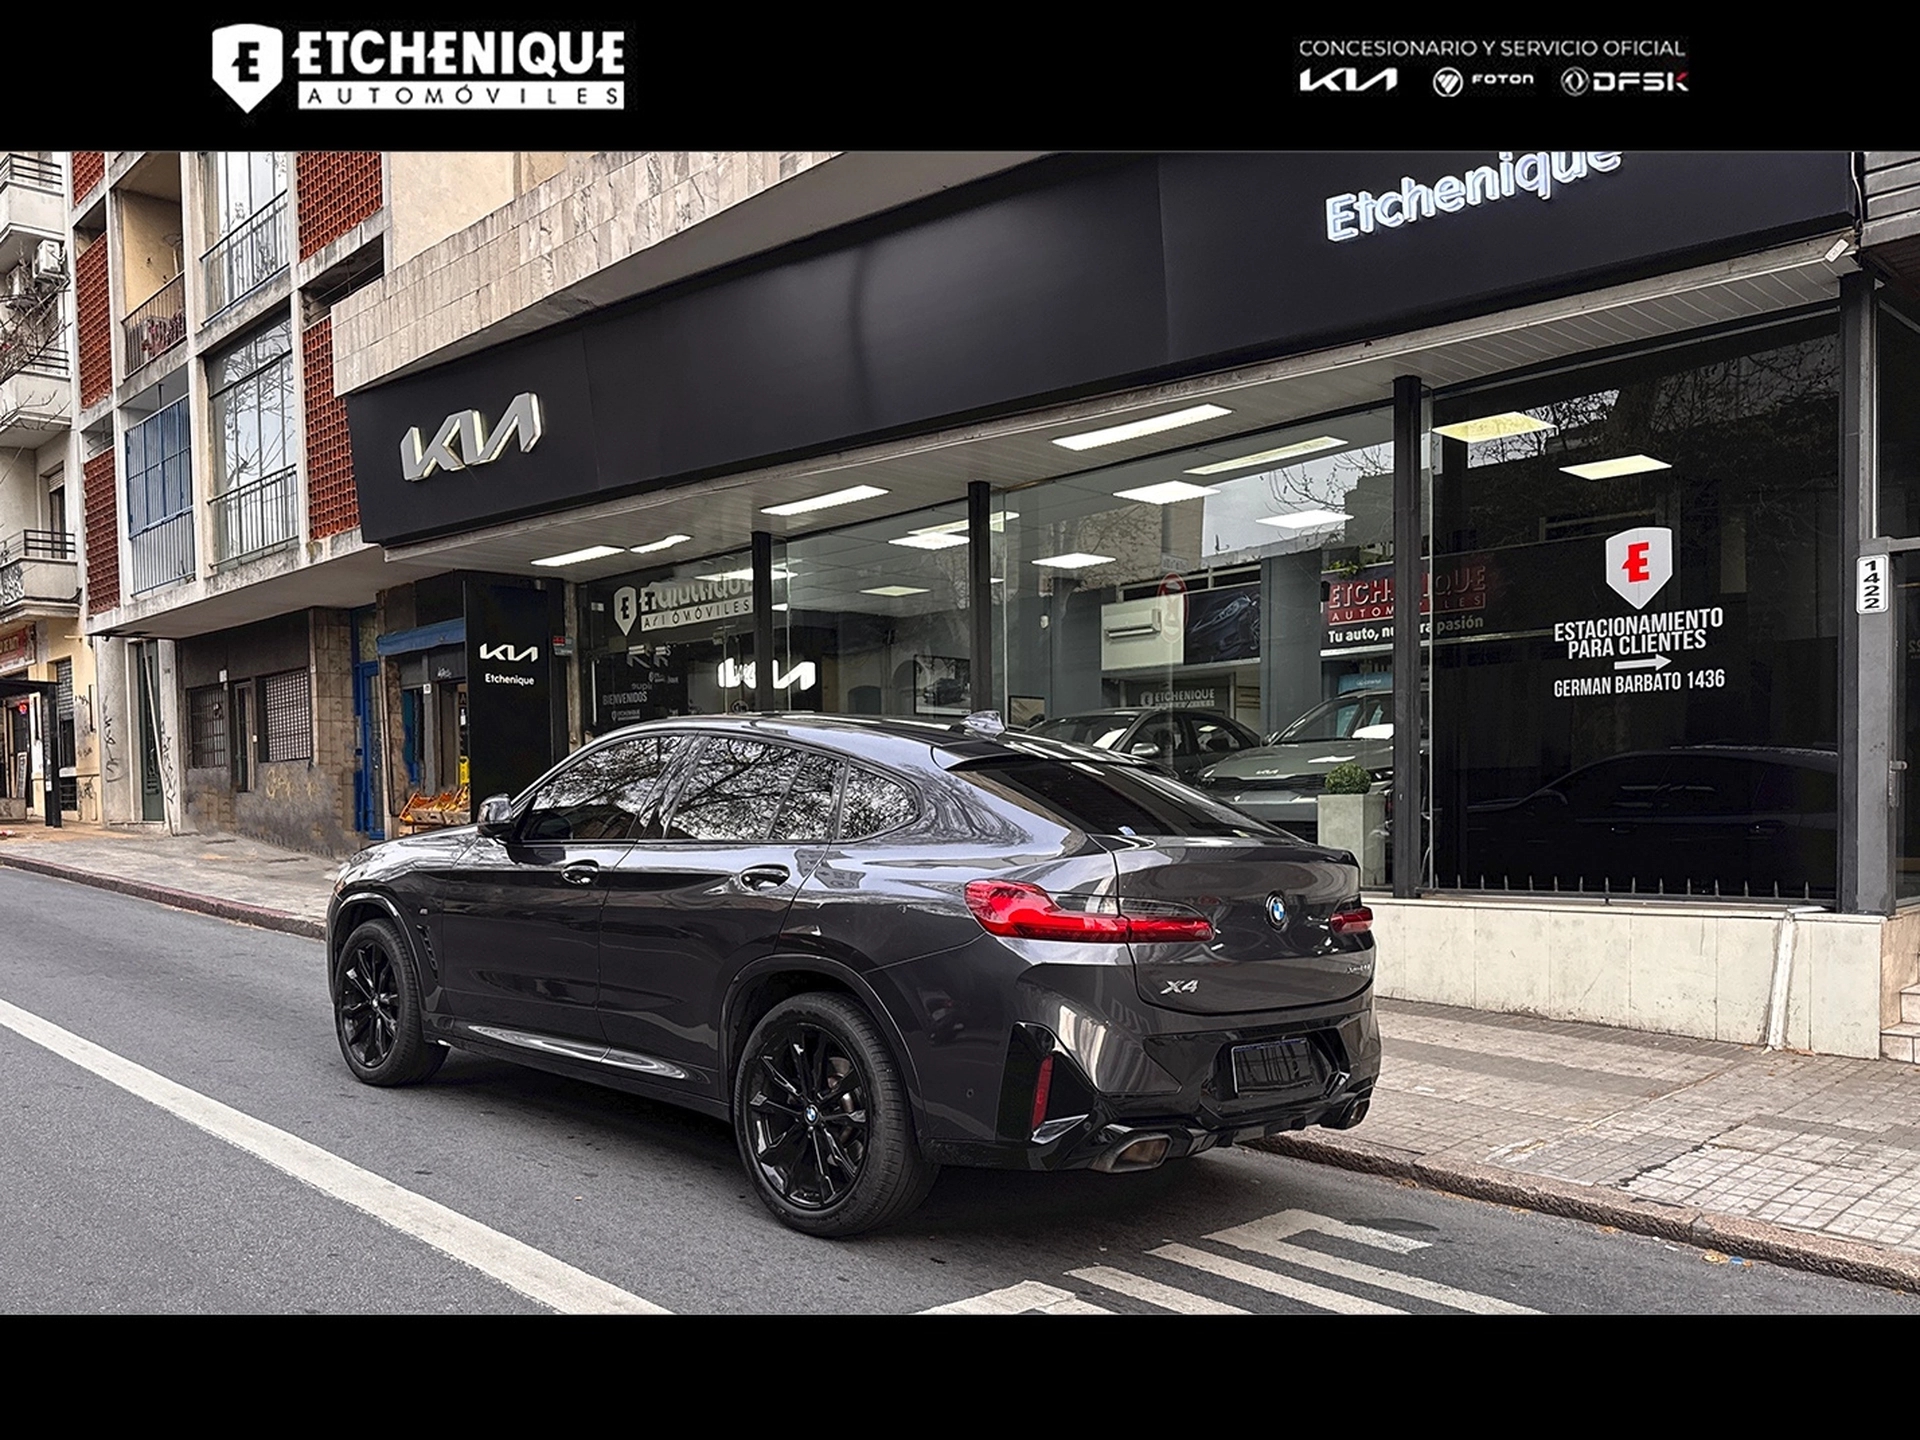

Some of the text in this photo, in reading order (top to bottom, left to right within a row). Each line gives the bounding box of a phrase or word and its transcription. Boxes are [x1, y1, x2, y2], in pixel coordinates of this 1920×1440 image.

[399, 391, 542, 482] KIA
[1863, 560, 1881, 610] 1422
[1328, 631, 1343, 643] Tu
[1345, 628, 1380, 642] auto,
[1436, 615, 1484, 635] pasión
[1554, 607, 1724, 642] ESTACIONAMIENTO
[479, 643, 539, 662] KIA
[1568, 629, 1707, 660] PARA CLIENTES
[485, 673, 535, 686] Etchenique
[1554, 668, 1726, 698] GERMAN BARBATO 1436
[1155, 688, 1215, 702] ETCHENIQUE
[1160, 980, 1199, 994] X4
